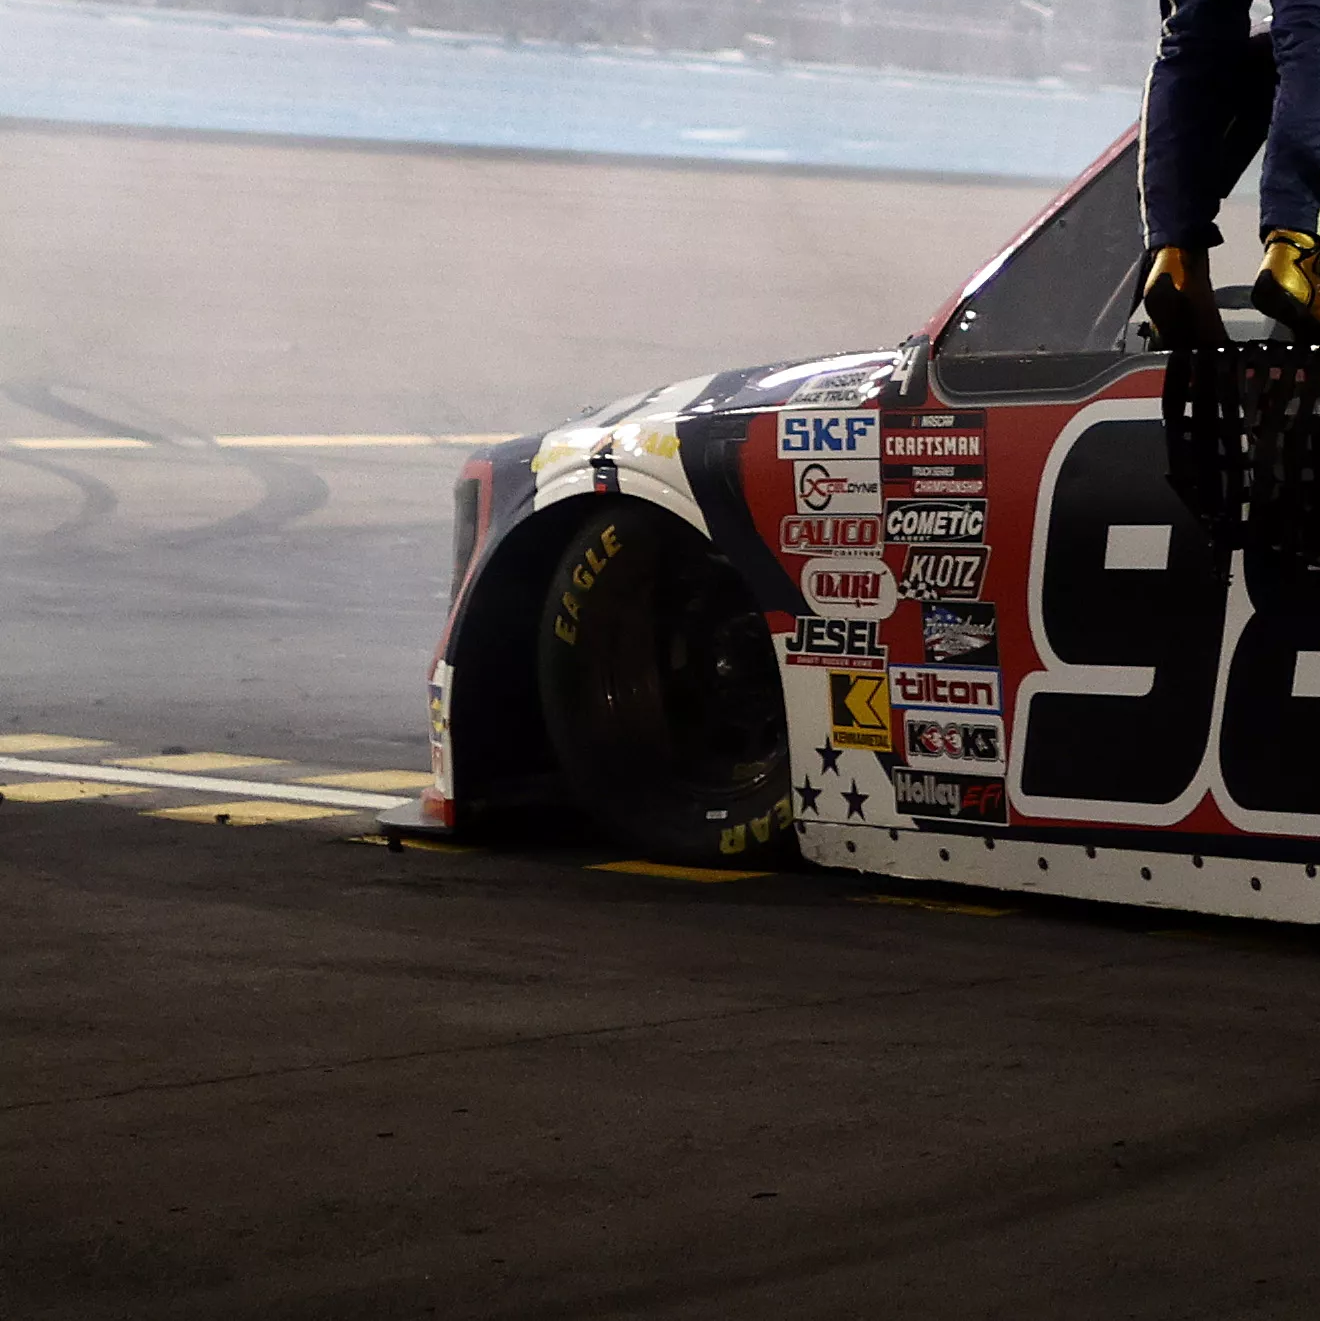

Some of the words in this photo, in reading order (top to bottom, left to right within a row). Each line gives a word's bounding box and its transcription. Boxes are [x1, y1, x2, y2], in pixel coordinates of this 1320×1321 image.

[782, 417, 876, 451] SKF
[885, 436, 981, 456] CRAFTSMAN
[783, 519, 876, 546] CALICO
[887, 508, 984, 536] COMETIC
[554, 524, 624, 647] EAGLE
[908, 554, 981, 589] KLOTZ
[785, 619, 886, 657] JESEL
[894, 672, 994, 706] tilton
[906, 721, 1000, 762] KOOKS
[895, 772, 962, 817] Holley
